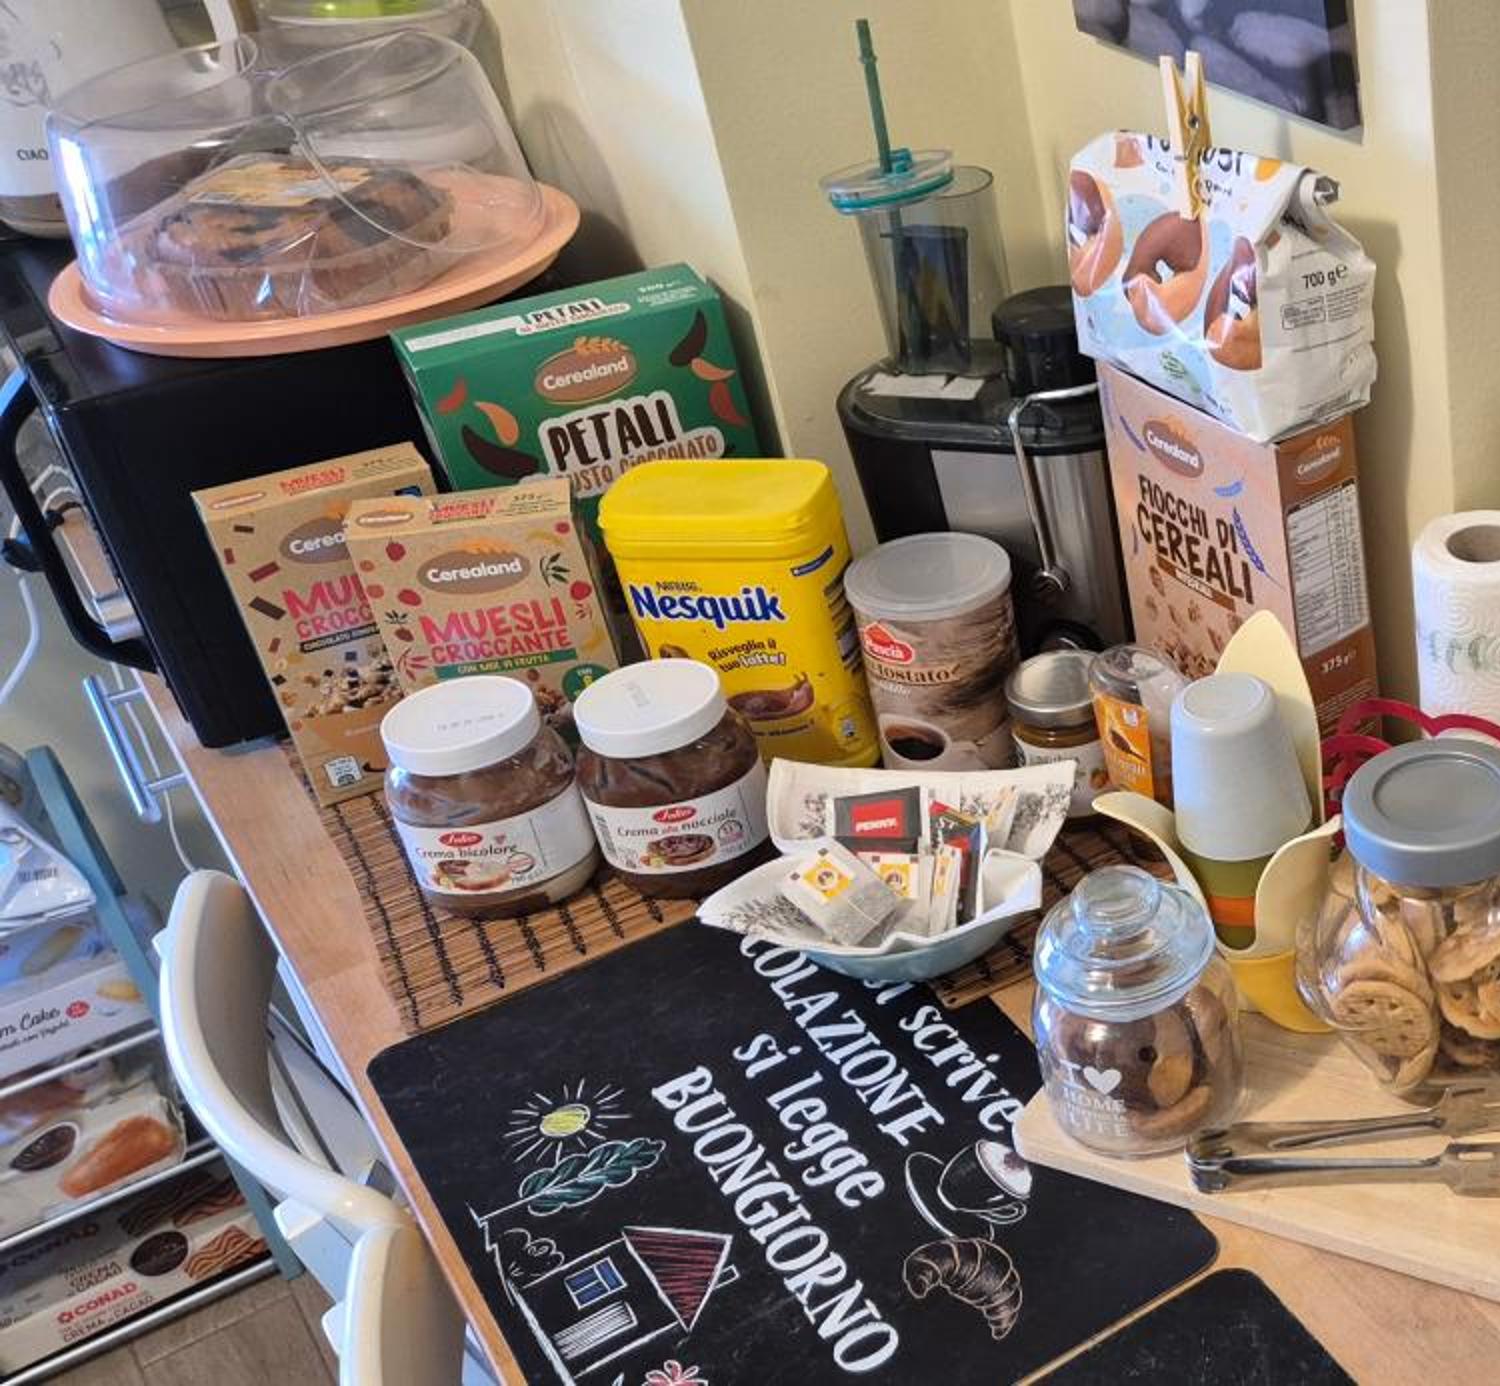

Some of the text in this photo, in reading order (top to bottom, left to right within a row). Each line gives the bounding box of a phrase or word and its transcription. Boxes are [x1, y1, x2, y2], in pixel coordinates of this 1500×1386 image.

[1302, 271, 1325, 289] 700
[543, 356, 630, 392] Cerealand
[546, 398, 679, 474] PETALI
[556, 462, 613, 492] USTO
[1138, 475, 1238, 553] FIOCCHI DI
[289, 531, 347, 555] Cerea
[1137, 503, 1254, 604] CEREALI
[426, 560, 523, 583] Cerealand
[296, 604, 375, 640] CROCC
[419, 597, 568, 645] MUESLI
[629, 584, 786, 630] Nesquik
[430, 627, 571, 667] CROCCANTE
[617, 825, 659, 838] Crema
[20, 1008, 61, 1031] Cake
[899, 1005, 1026, 1133] scrive
[733, 1033, 886, 1208] si legge
[651, 1065, 900, 1373] BUONGIORNO
[72, 1281, 138, 1317] CONAD
